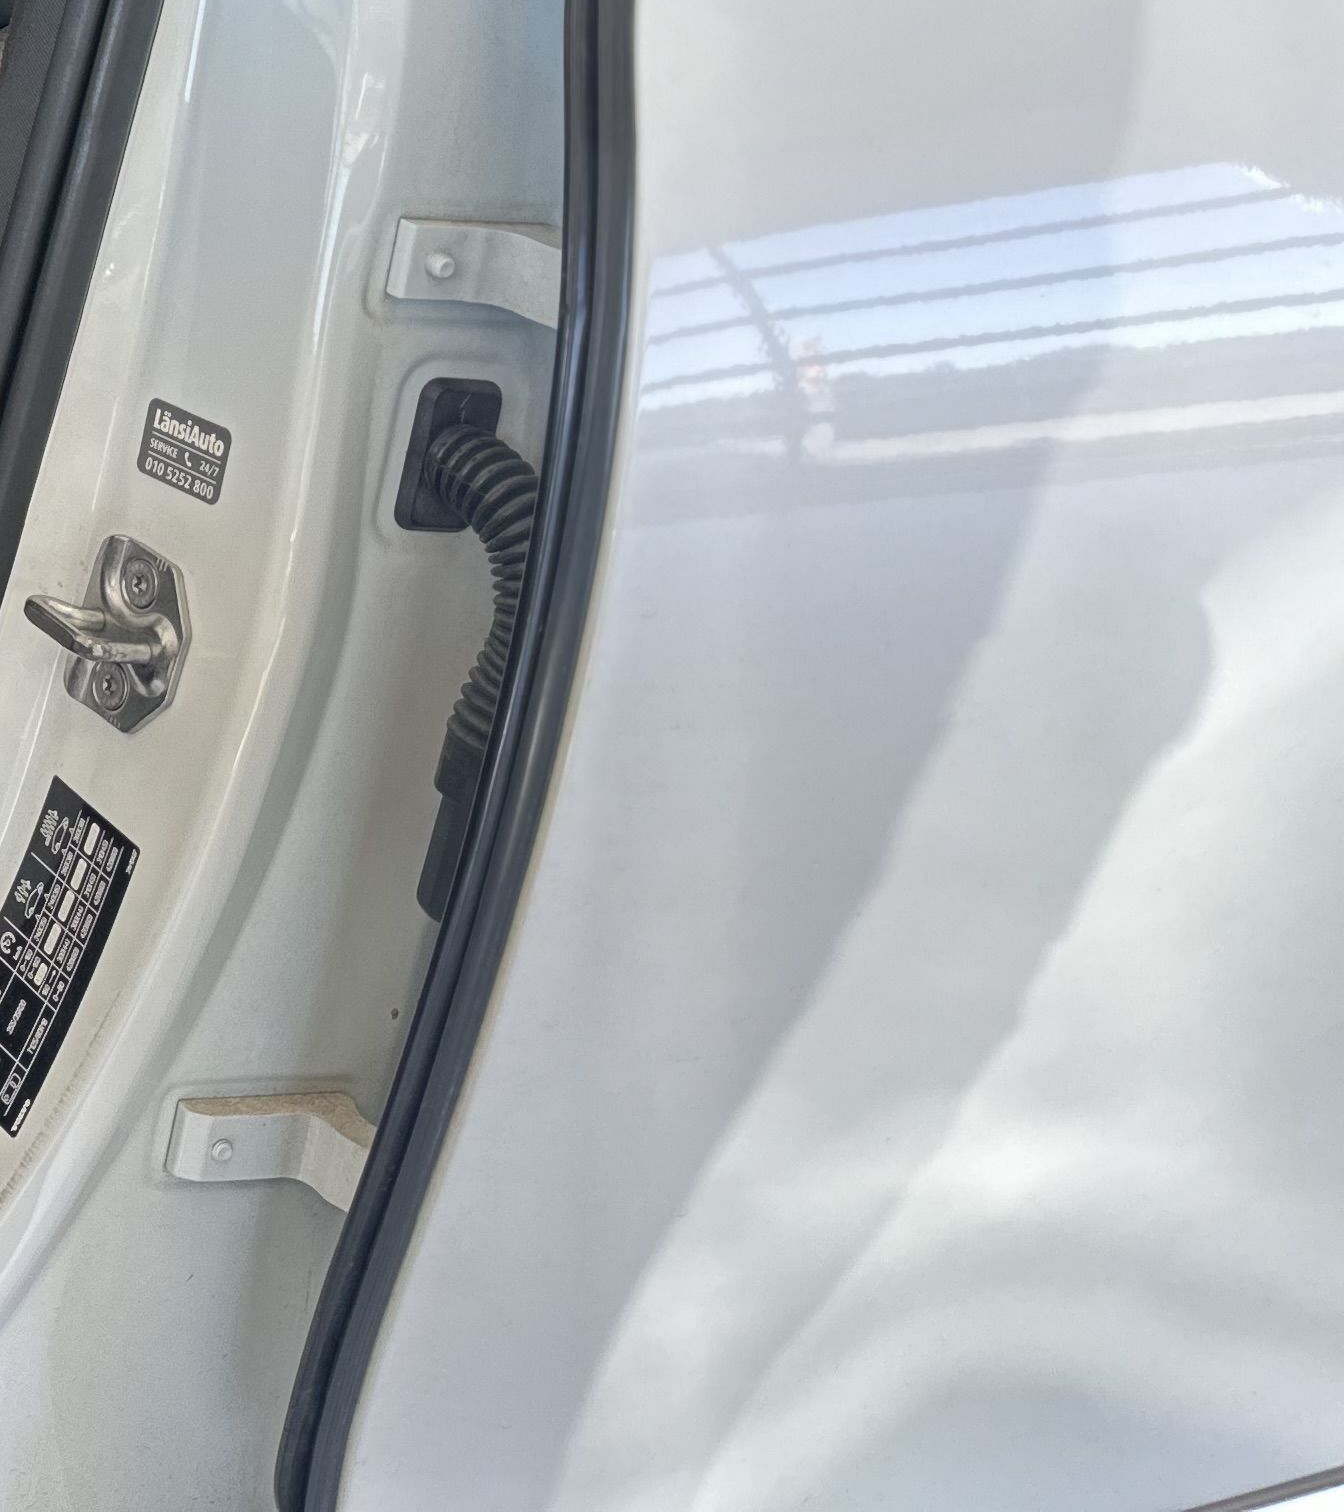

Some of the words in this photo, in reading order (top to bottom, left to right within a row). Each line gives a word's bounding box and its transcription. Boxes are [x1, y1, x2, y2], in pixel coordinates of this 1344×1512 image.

[153, 408, 225, 457] LänsiAuto
[145, 457, 165, 476] 010
[166, 467, 192, 489] 5252
[193, 479, 214, 500] 800
[150, 438, 179, 459] SERVICE
[199, 461, 220, 477] 24/7
